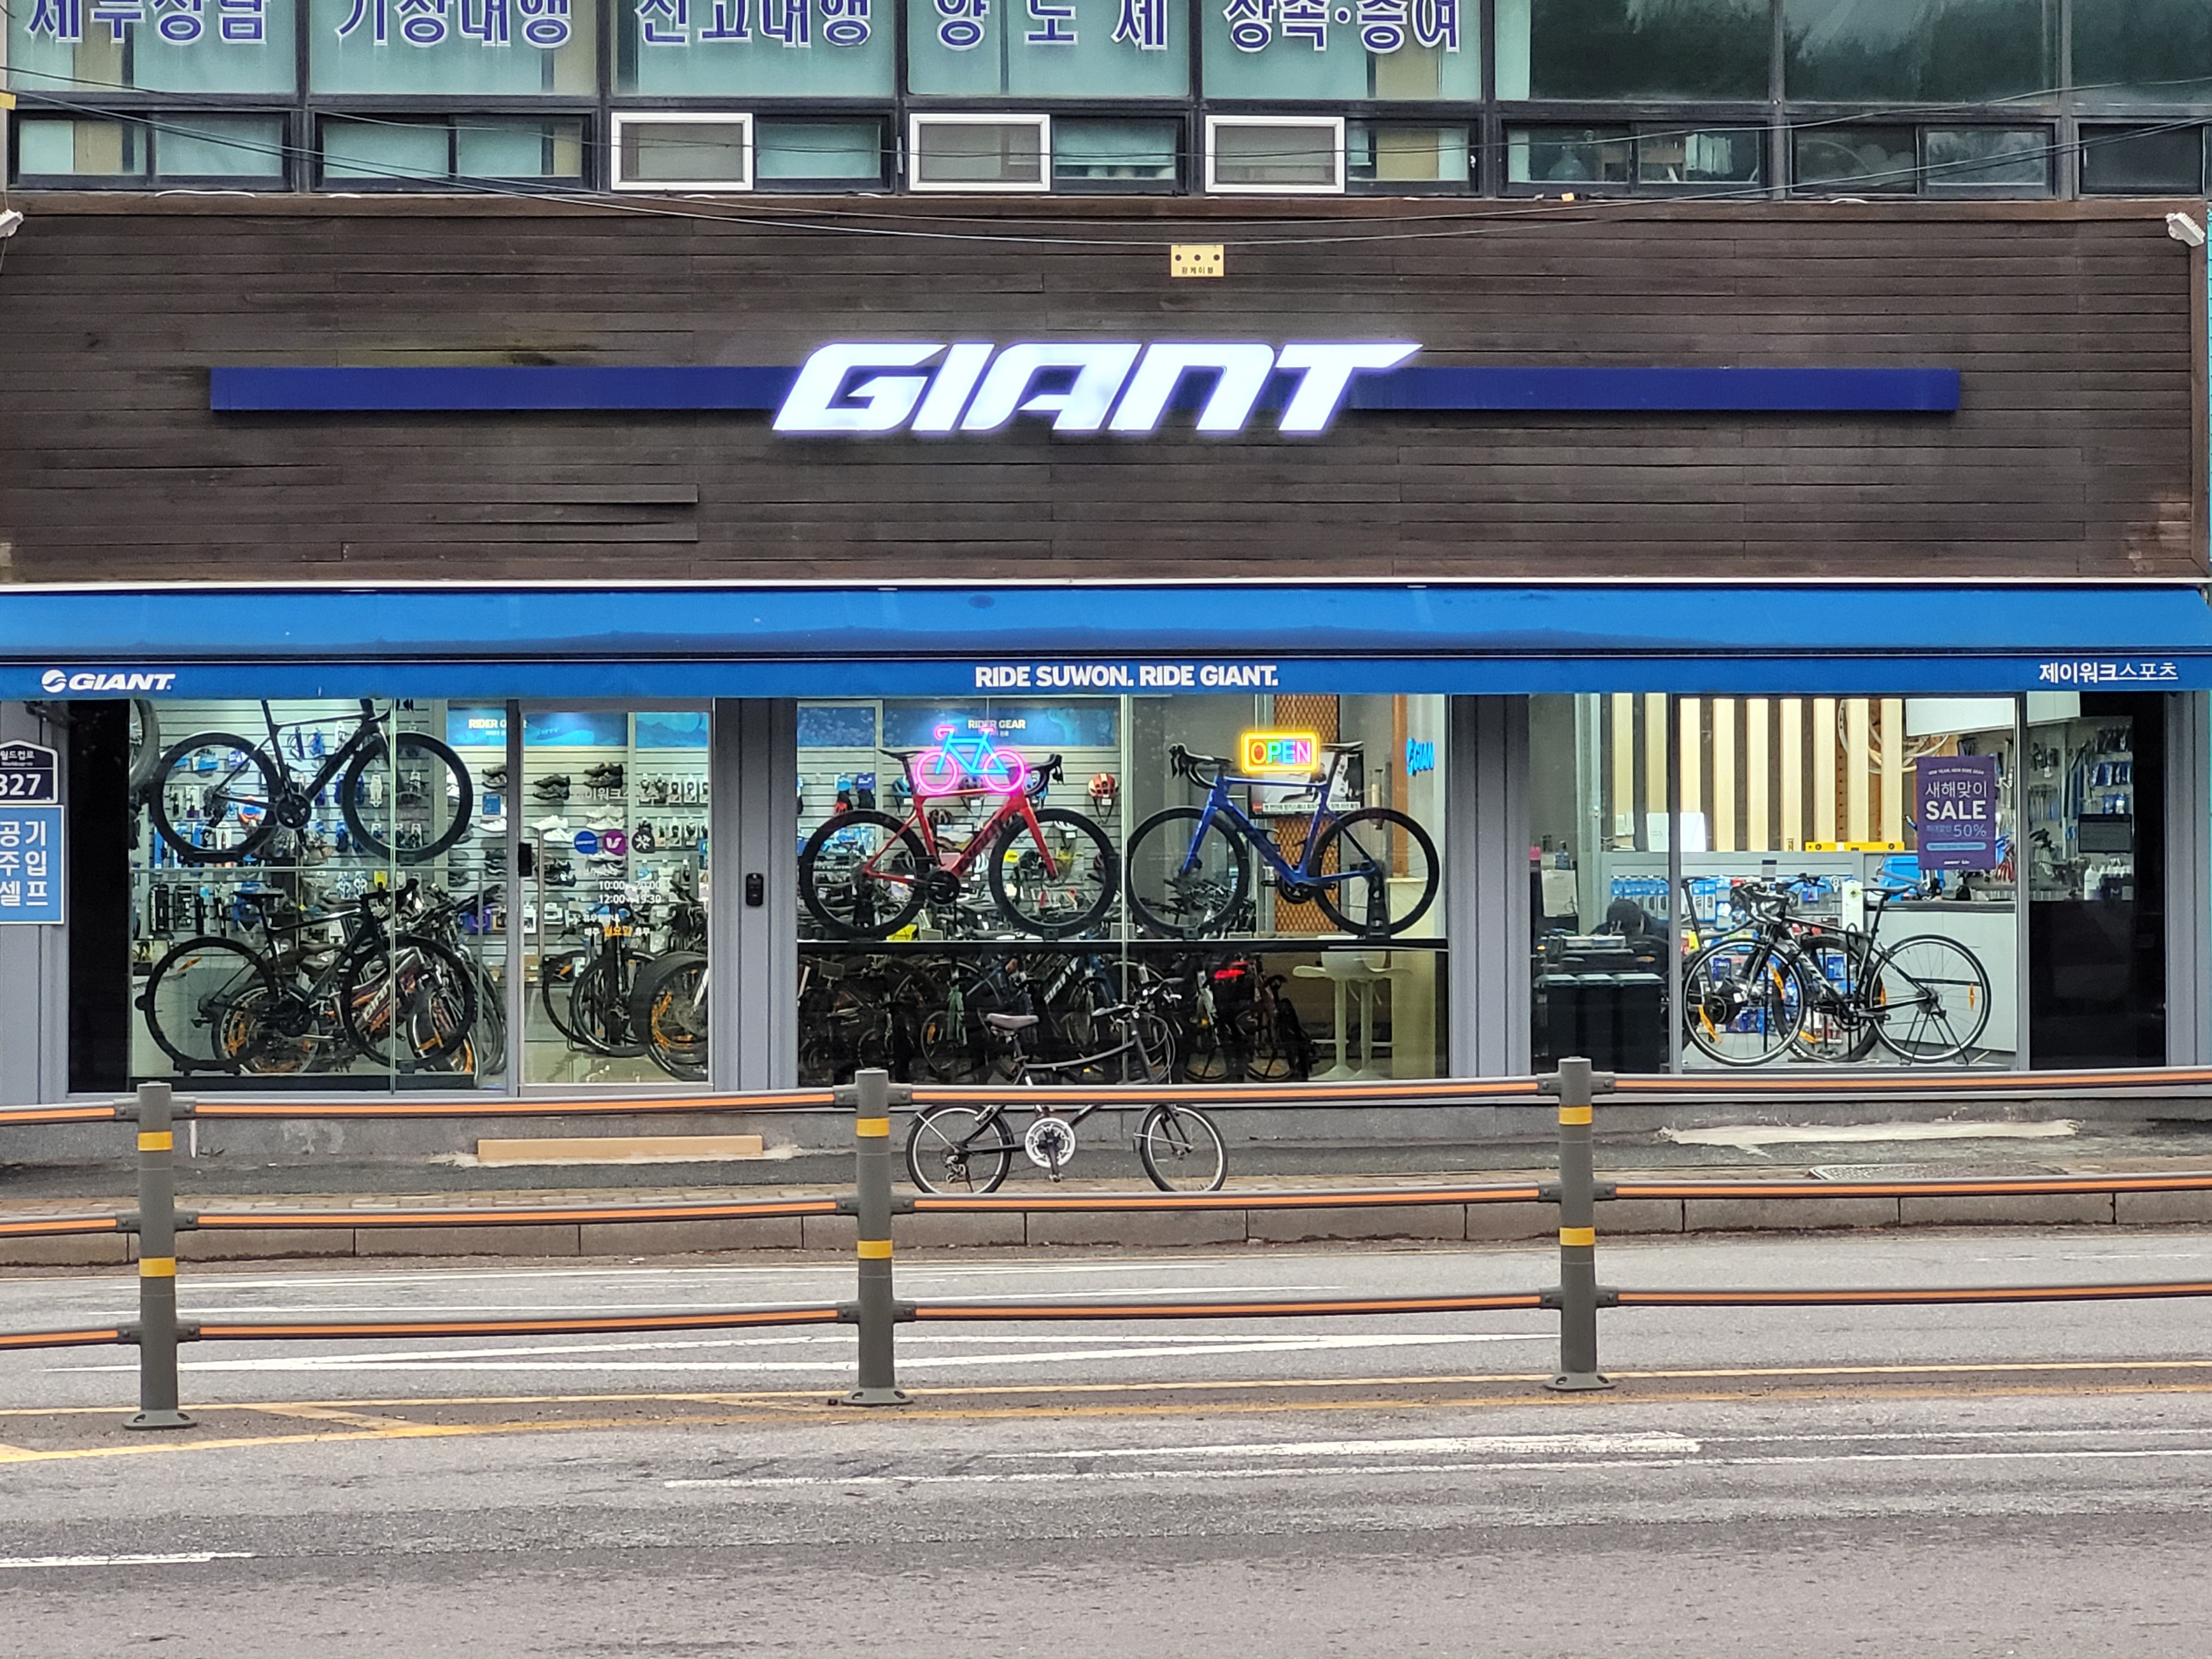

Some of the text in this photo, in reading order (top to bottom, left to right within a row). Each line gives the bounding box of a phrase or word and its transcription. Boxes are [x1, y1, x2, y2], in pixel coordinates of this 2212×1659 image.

[772, 343, 1424, 432] GIANT
[69, 673, 176, 690] GIANT
[975, 664, 1278, 687] RIDE SUWON. RIDE GIANT.
[2039, 662, 2179, 684] 제이워크스포츠
[468, 719, 498, 729] RIDER
[968, 720, 1026, 729] RIDER GEAR
[1251, 741, 1311, 764] OPEN
[1414, 742, 1435, 771] GIAN
[1925, 781, 1987, 798] 새해맞이
[1926, 800, 1987, 820] SALE
[0, 821, 47, 848] 공기
[1953, 824, 1987, 837] 50%
[0, 850, 47, 877] 주입
[0, 881, 49, 906] 셀프
[599, 881, 625, 890] 10:00
[599, 894, 625, 904] 12:00
